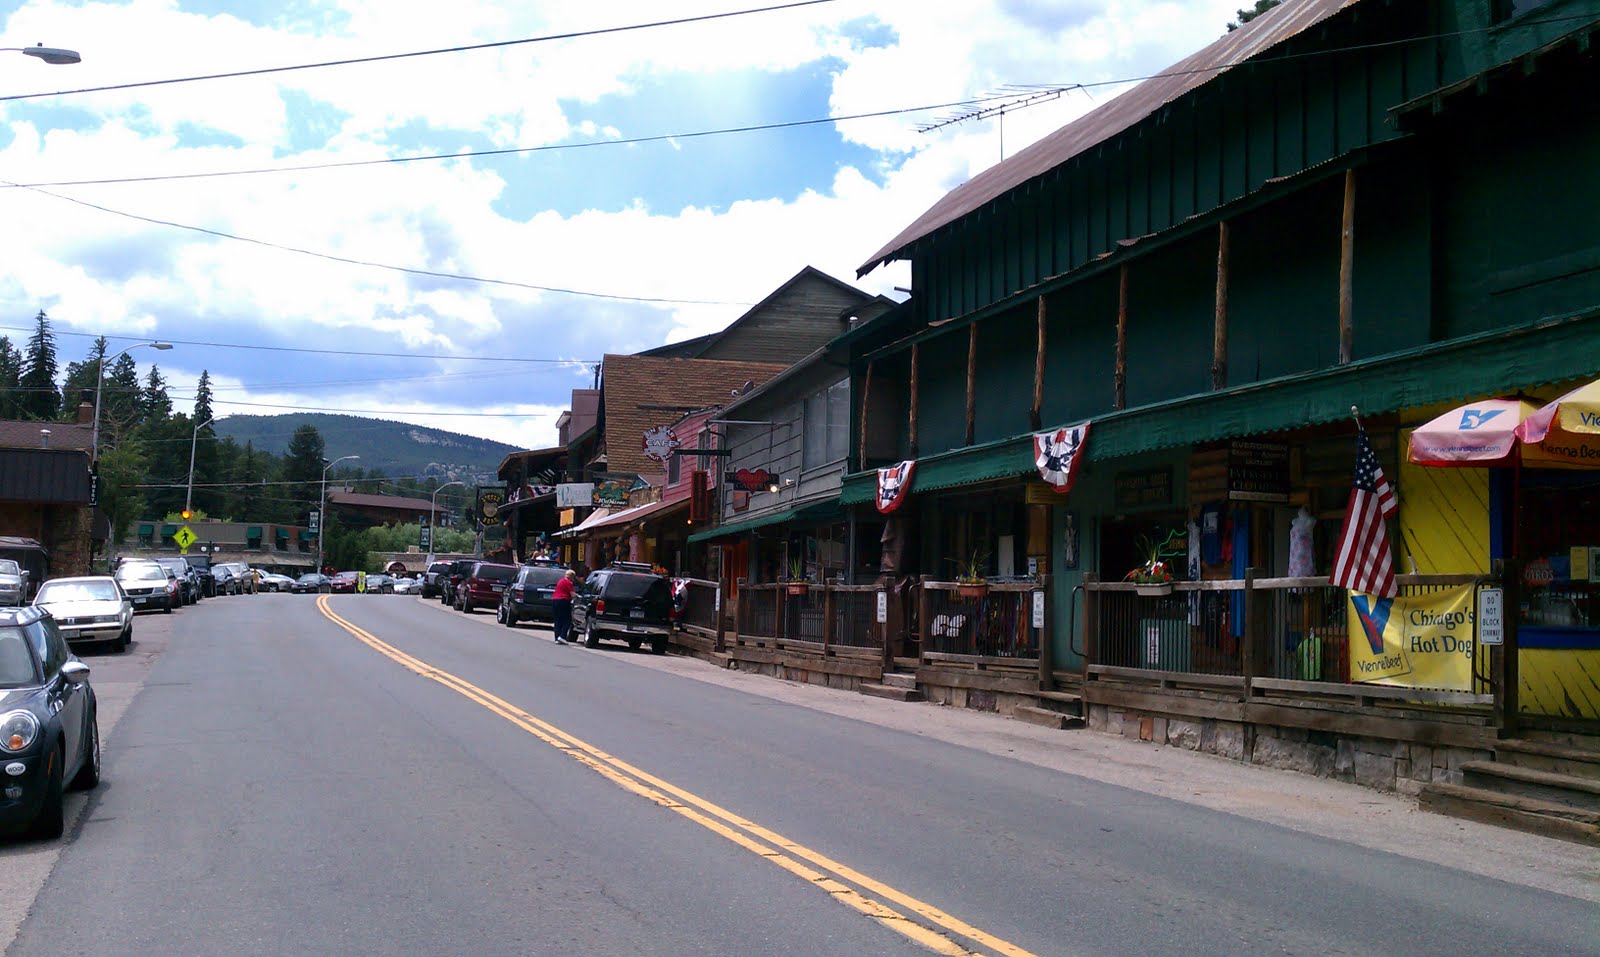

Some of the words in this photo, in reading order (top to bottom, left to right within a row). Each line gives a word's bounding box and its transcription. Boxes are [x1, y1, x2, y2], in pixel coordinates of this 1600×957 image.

[645, 439, 676, 447] CAFE
[1487, 597, 1495, 605] DO
[1485, 607, 1497, 616] NOT
[1482, 618, 1500, 626] BLOCK
[1411, 636, 1440, 653] Hot
[1441, 635, 1472, 659] Dog
[7, 765, 24, 773] WOOF
